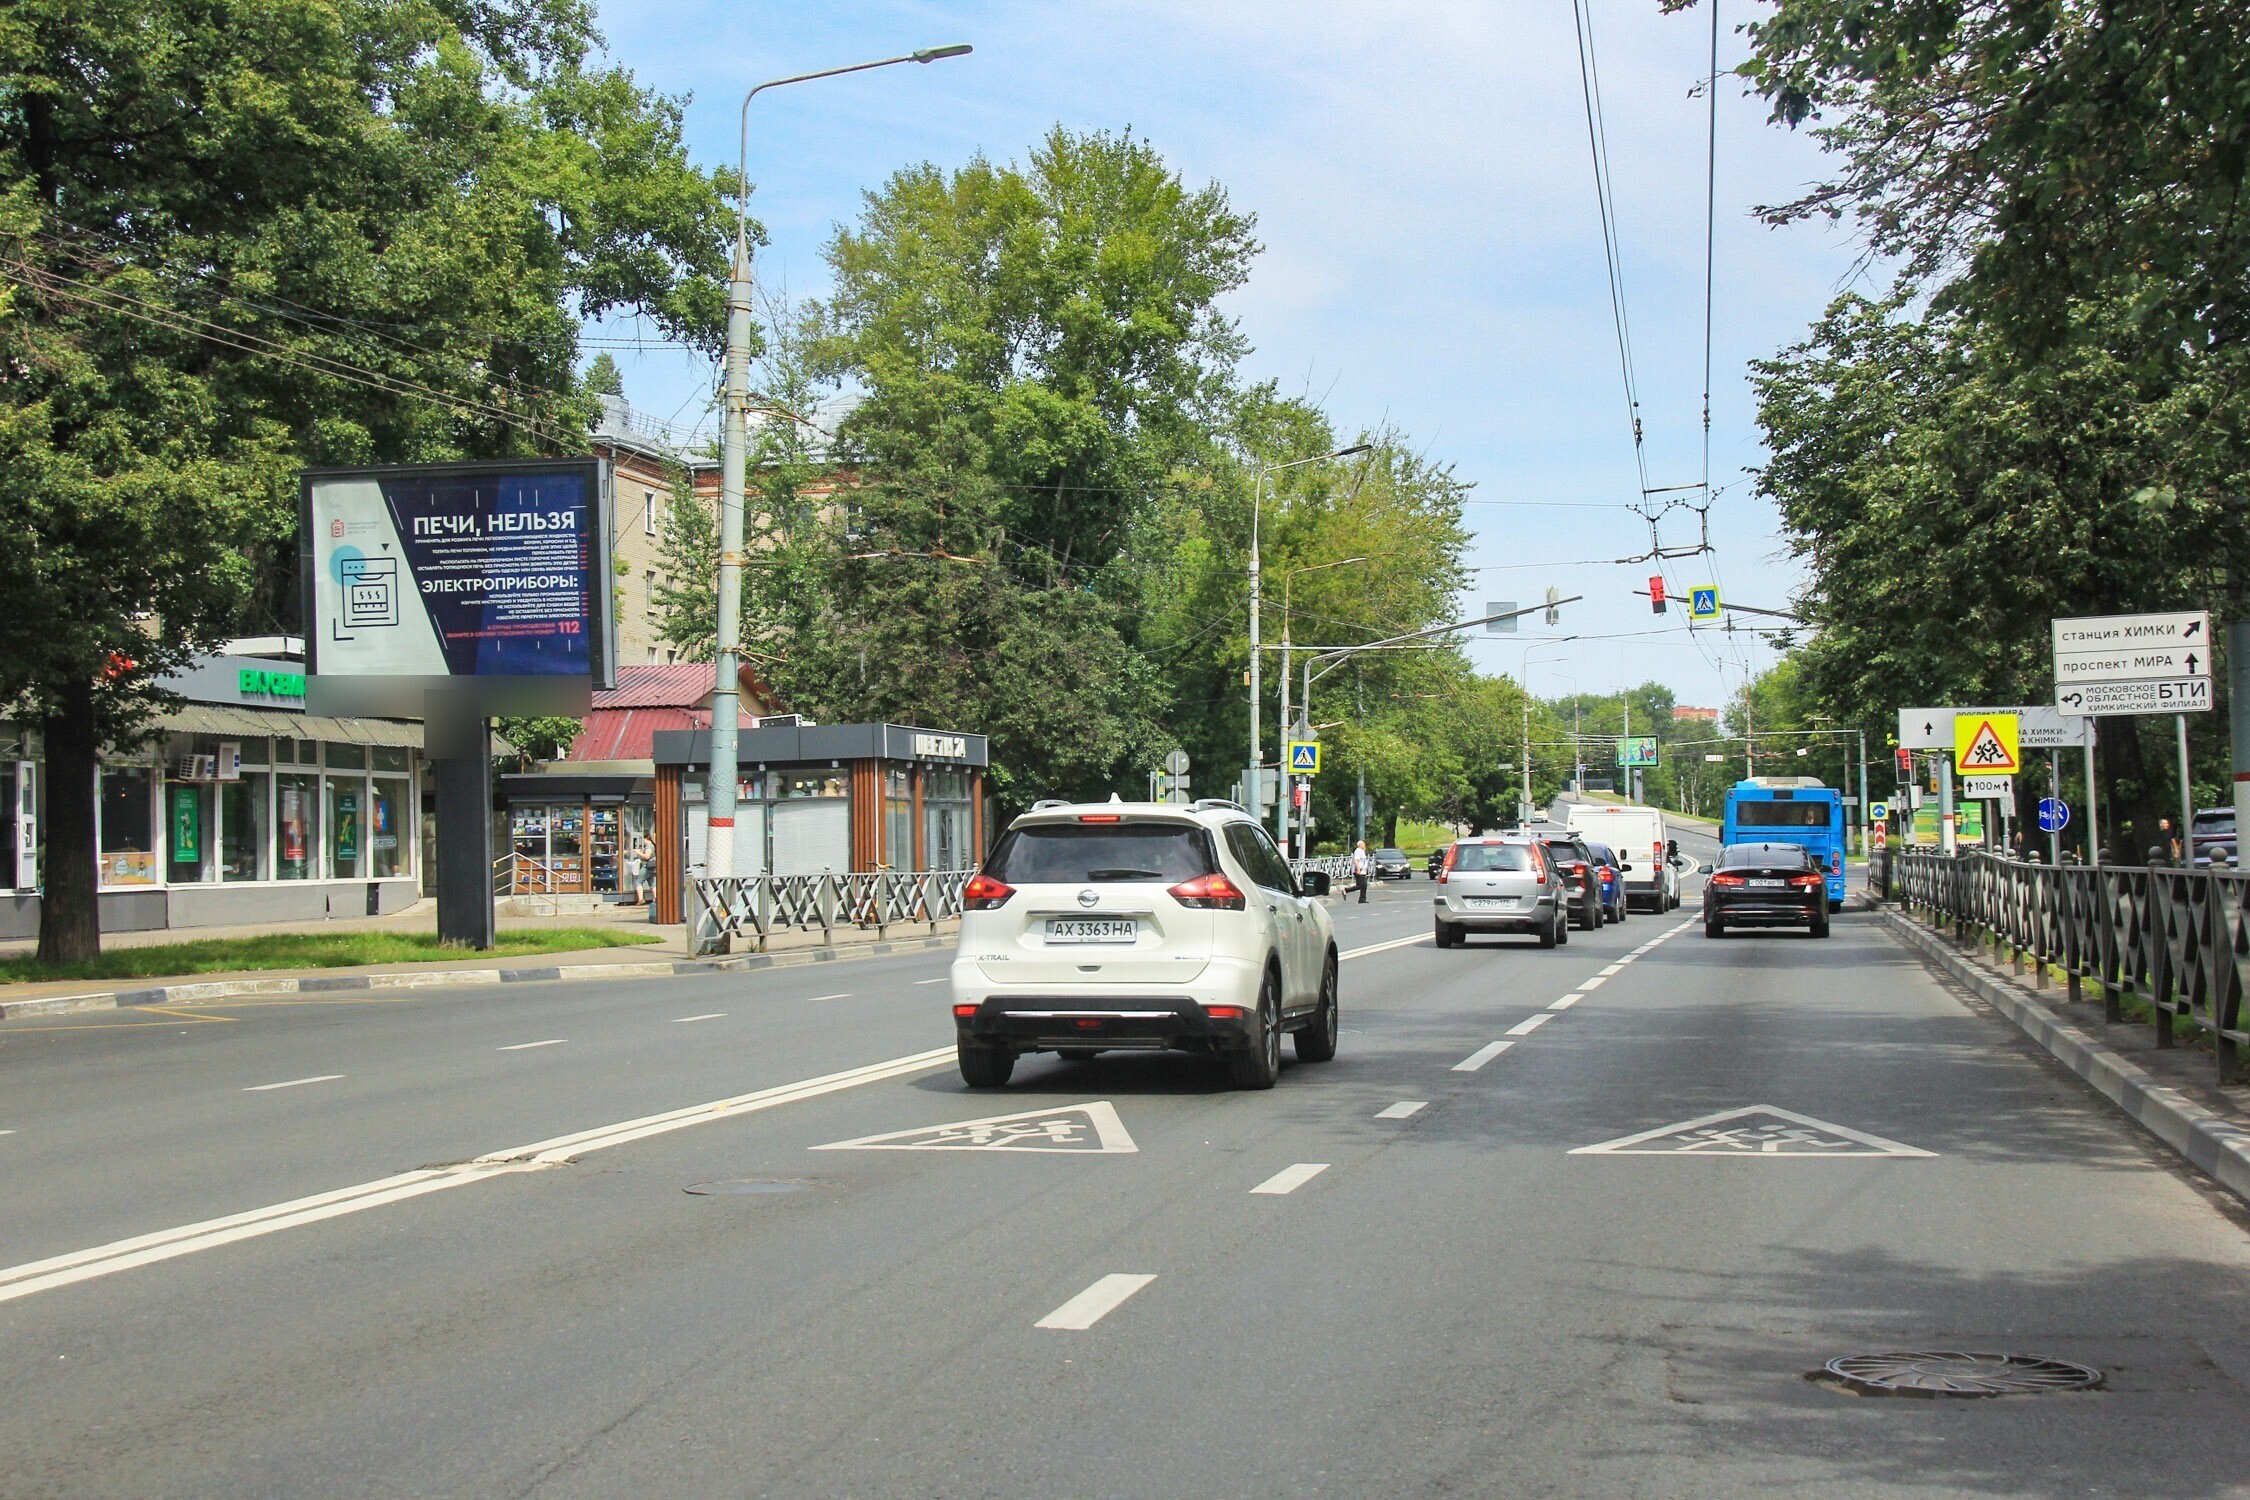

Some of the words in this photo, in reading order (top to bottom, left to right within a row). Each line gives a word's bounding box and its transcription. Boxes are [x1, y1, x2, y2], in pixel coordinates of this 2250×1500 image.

[414, 514, 480, 536] ПЕЧИ,
[488, 511, 575, 532] НЕЛЬЗЯ
[422, 576, 578, 592] ЭЛЕКТРОПРИБОРЫ:
[558, 621, 580, 634] 112
[2062, 629, 2119, 641] станция
[2124, 625, 2175, 637] ХИМКИ
[2063, 660, 2127, 673] проспект
[2134, 656, 2173, 667] МИРА
[2086, 684, 2156, 694] МОСКОВСКОЕ
[2159, 682, 2205, 698] БТИ
[2086, 693, 2156, 702] ОБЛАСТНОЕ
[2087, 701, 2157, 712] ХИМКИНСКИЙ
[2161, 700, 2205, 709] ФИЛИАЛ
[1077, 923, 1109, 936] 3363
